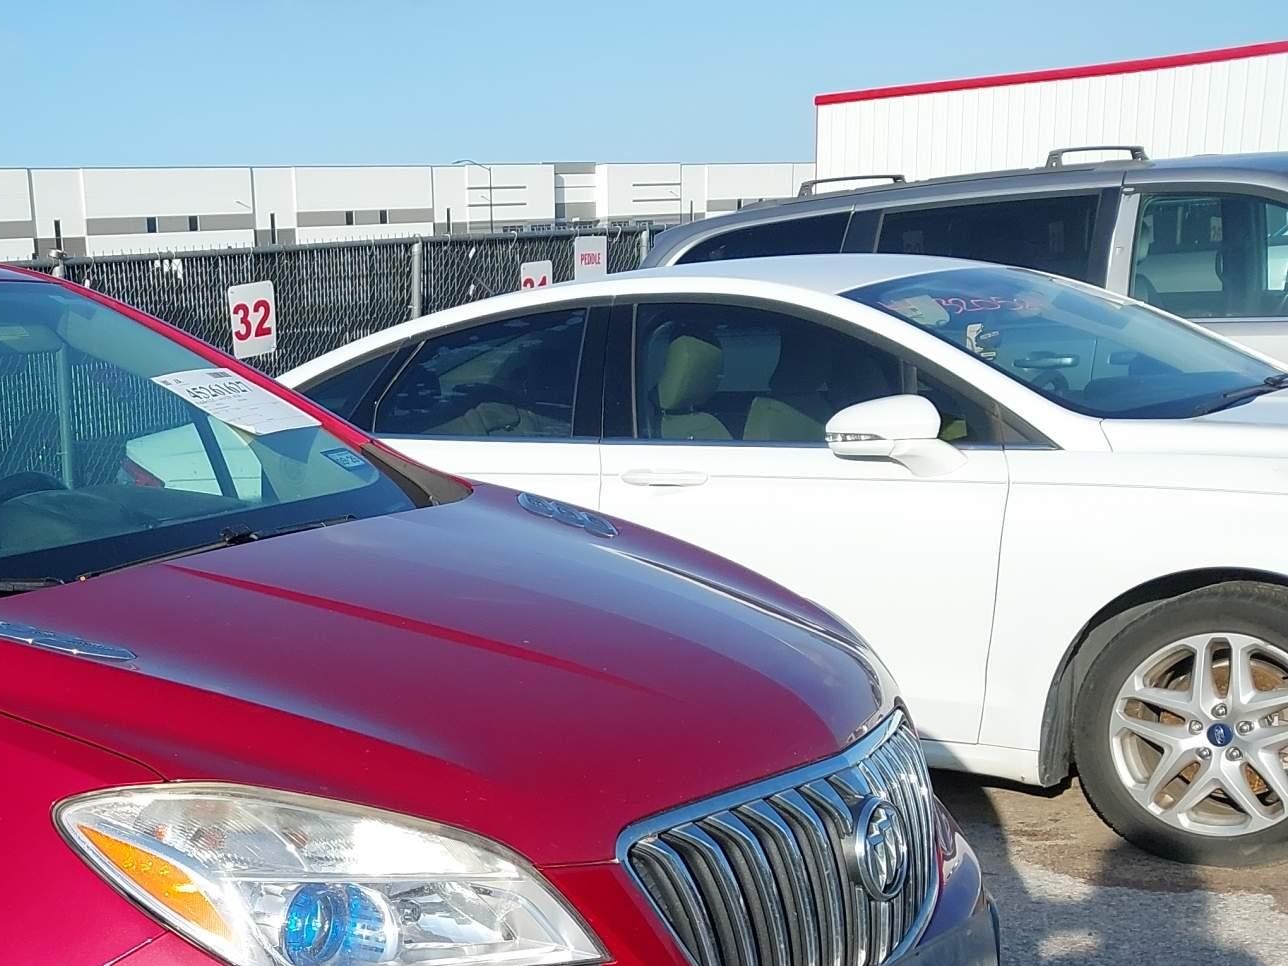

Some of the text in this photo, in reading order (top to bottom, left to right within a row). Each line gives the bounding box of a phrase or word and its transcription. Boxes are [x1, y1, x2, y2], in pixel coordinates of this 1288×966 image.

[580, 252, 601, 265] PEDDLE
[233, 300, 272, 340] 32
[185, 380, 253, 400] 45261627
